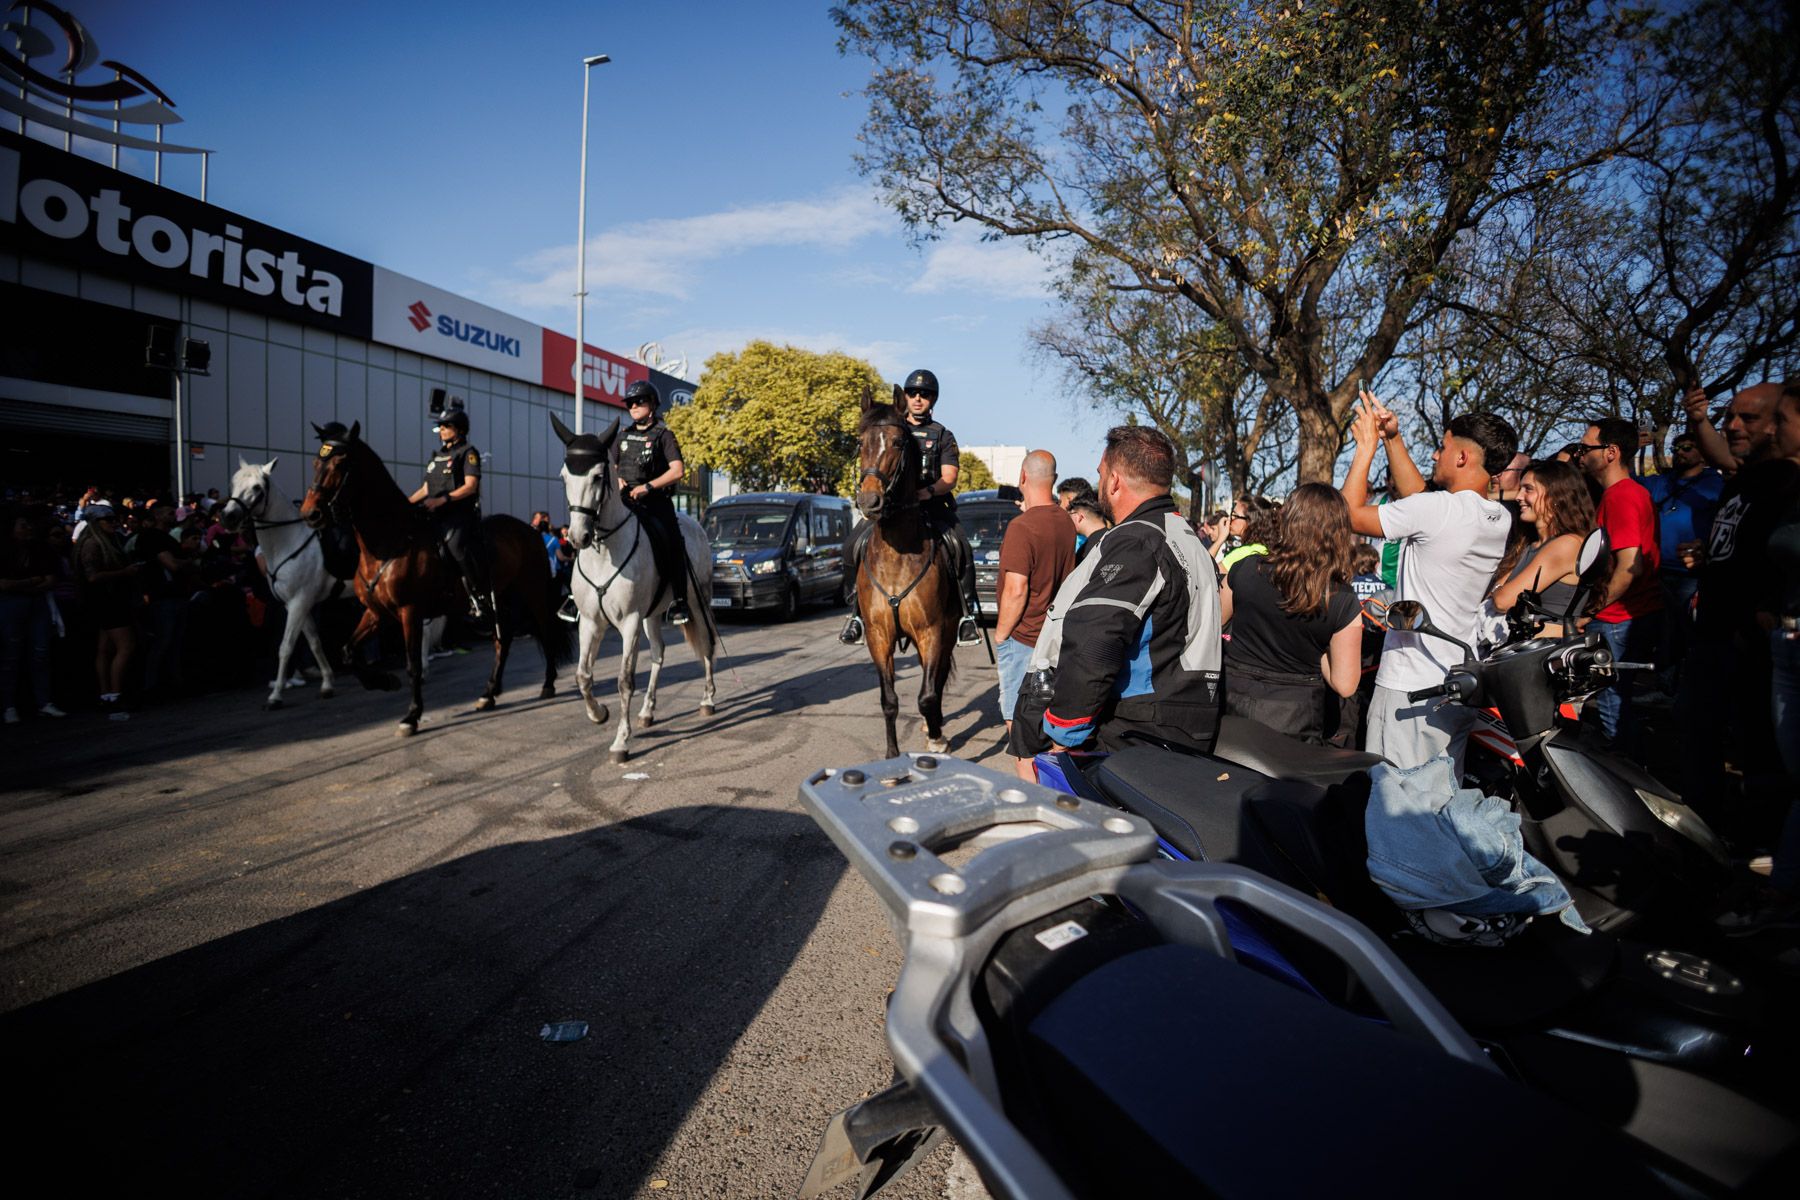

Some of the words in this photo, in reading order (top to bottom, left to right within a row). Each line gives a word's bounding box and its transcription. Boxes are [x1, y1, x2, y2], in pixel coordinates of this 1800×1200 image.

[0, 147, 344, 318] otorista
[437, 314, 520, 358] SUZUKI
[571, 351, 627, 398] GIVI
[1352, 581, 1386, 593] TECATE
